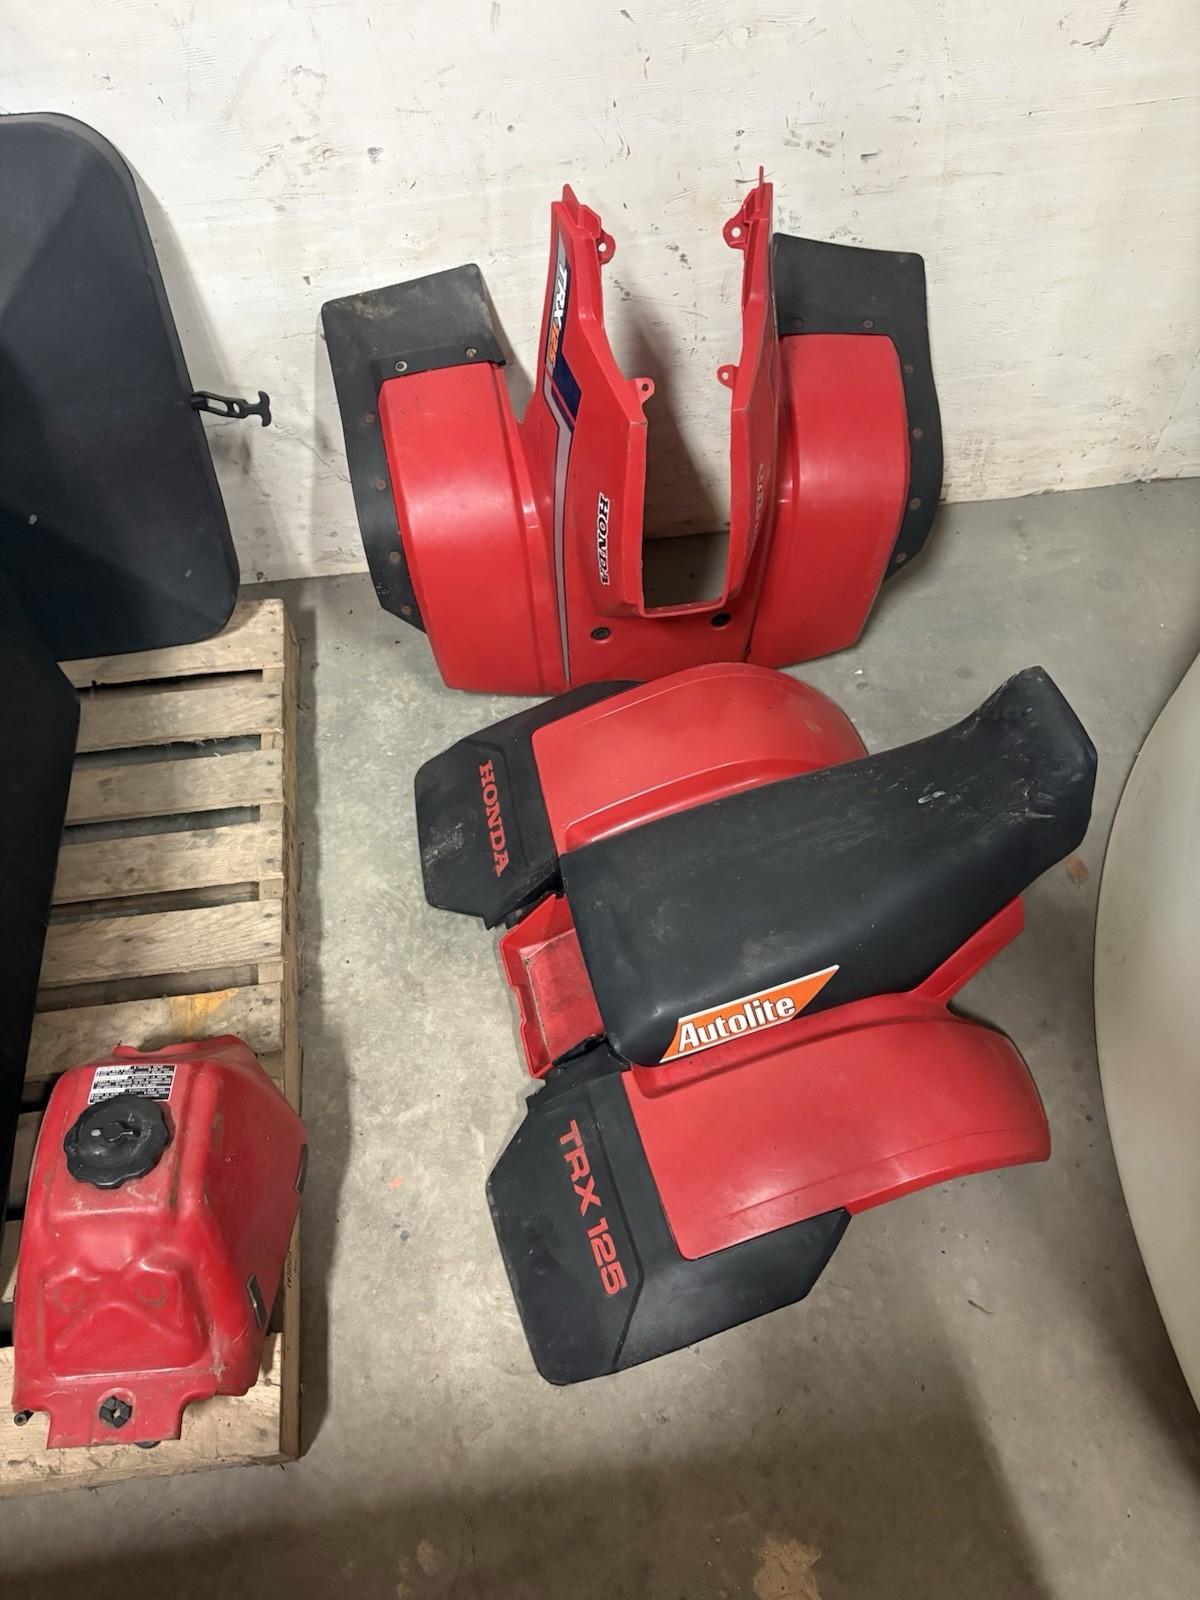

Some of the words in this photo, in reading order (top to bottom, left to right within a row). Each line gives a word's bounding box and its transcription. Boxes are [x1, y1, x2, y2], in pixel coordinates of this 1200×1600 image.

[597, 492, 610, 585] HONDA
[478, 758, 510, 878] HONDA
[678, 996, 796, 1053] Autolite
[559, 1118, 602, 1217] TRX
[587, 1216, 628, 1296] 125
